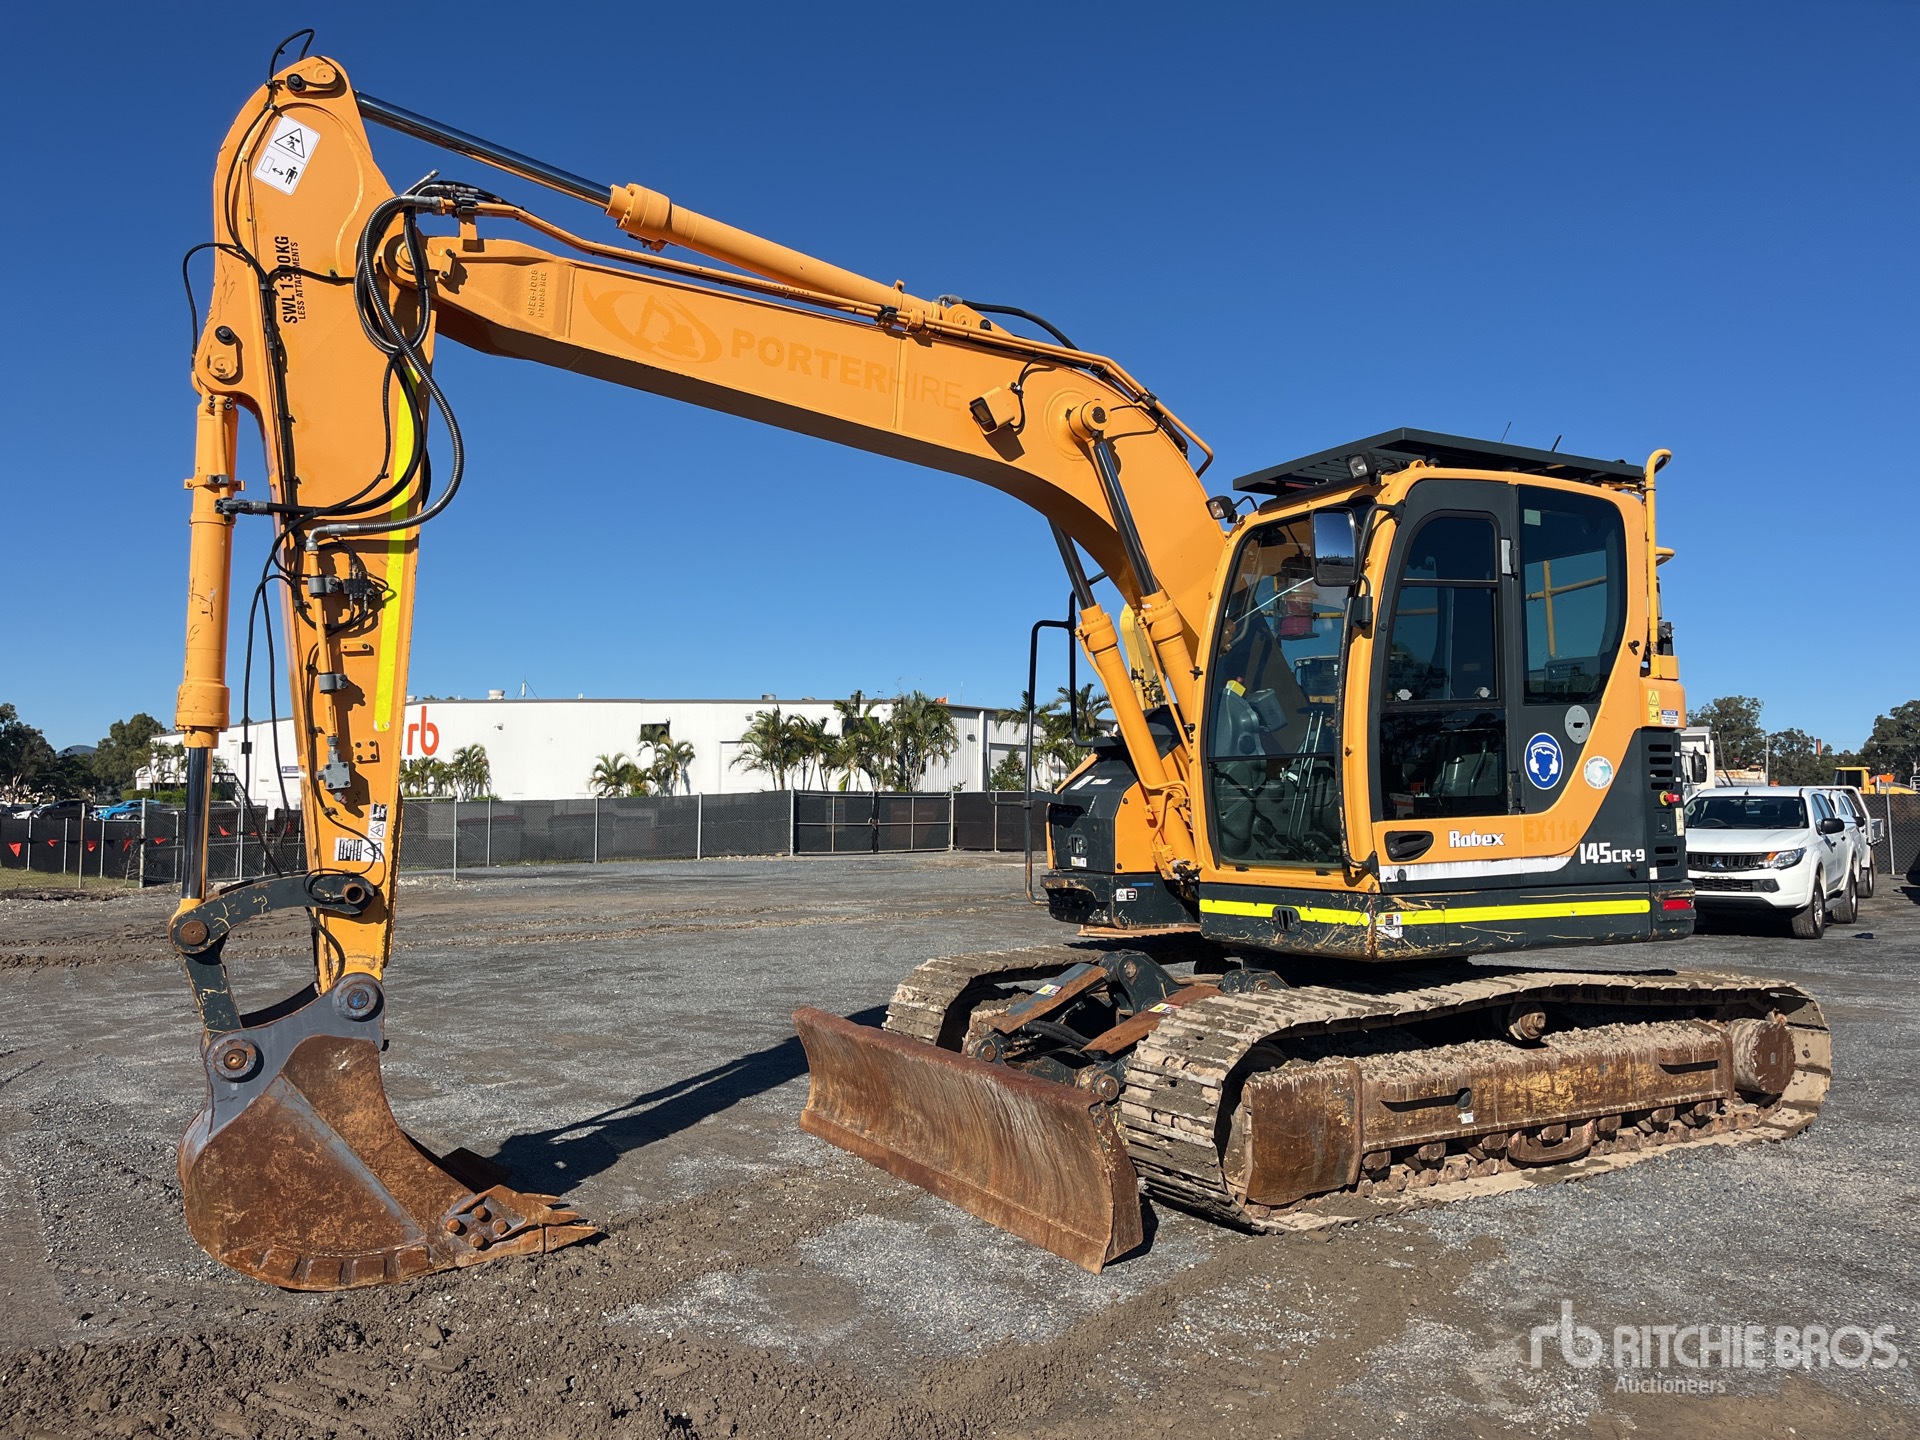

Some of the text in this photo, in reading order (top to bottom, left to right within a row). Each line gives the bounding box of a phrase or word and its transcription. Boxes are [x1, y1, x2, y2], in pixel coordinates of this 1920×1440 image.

[274, 236, 298, 324] SWL 130KG
[290, 242, 306, 320] LESS ATTACMENTS
[407, 705, 440, 756] rb
[1448, 830, 1506, 848] Robex
